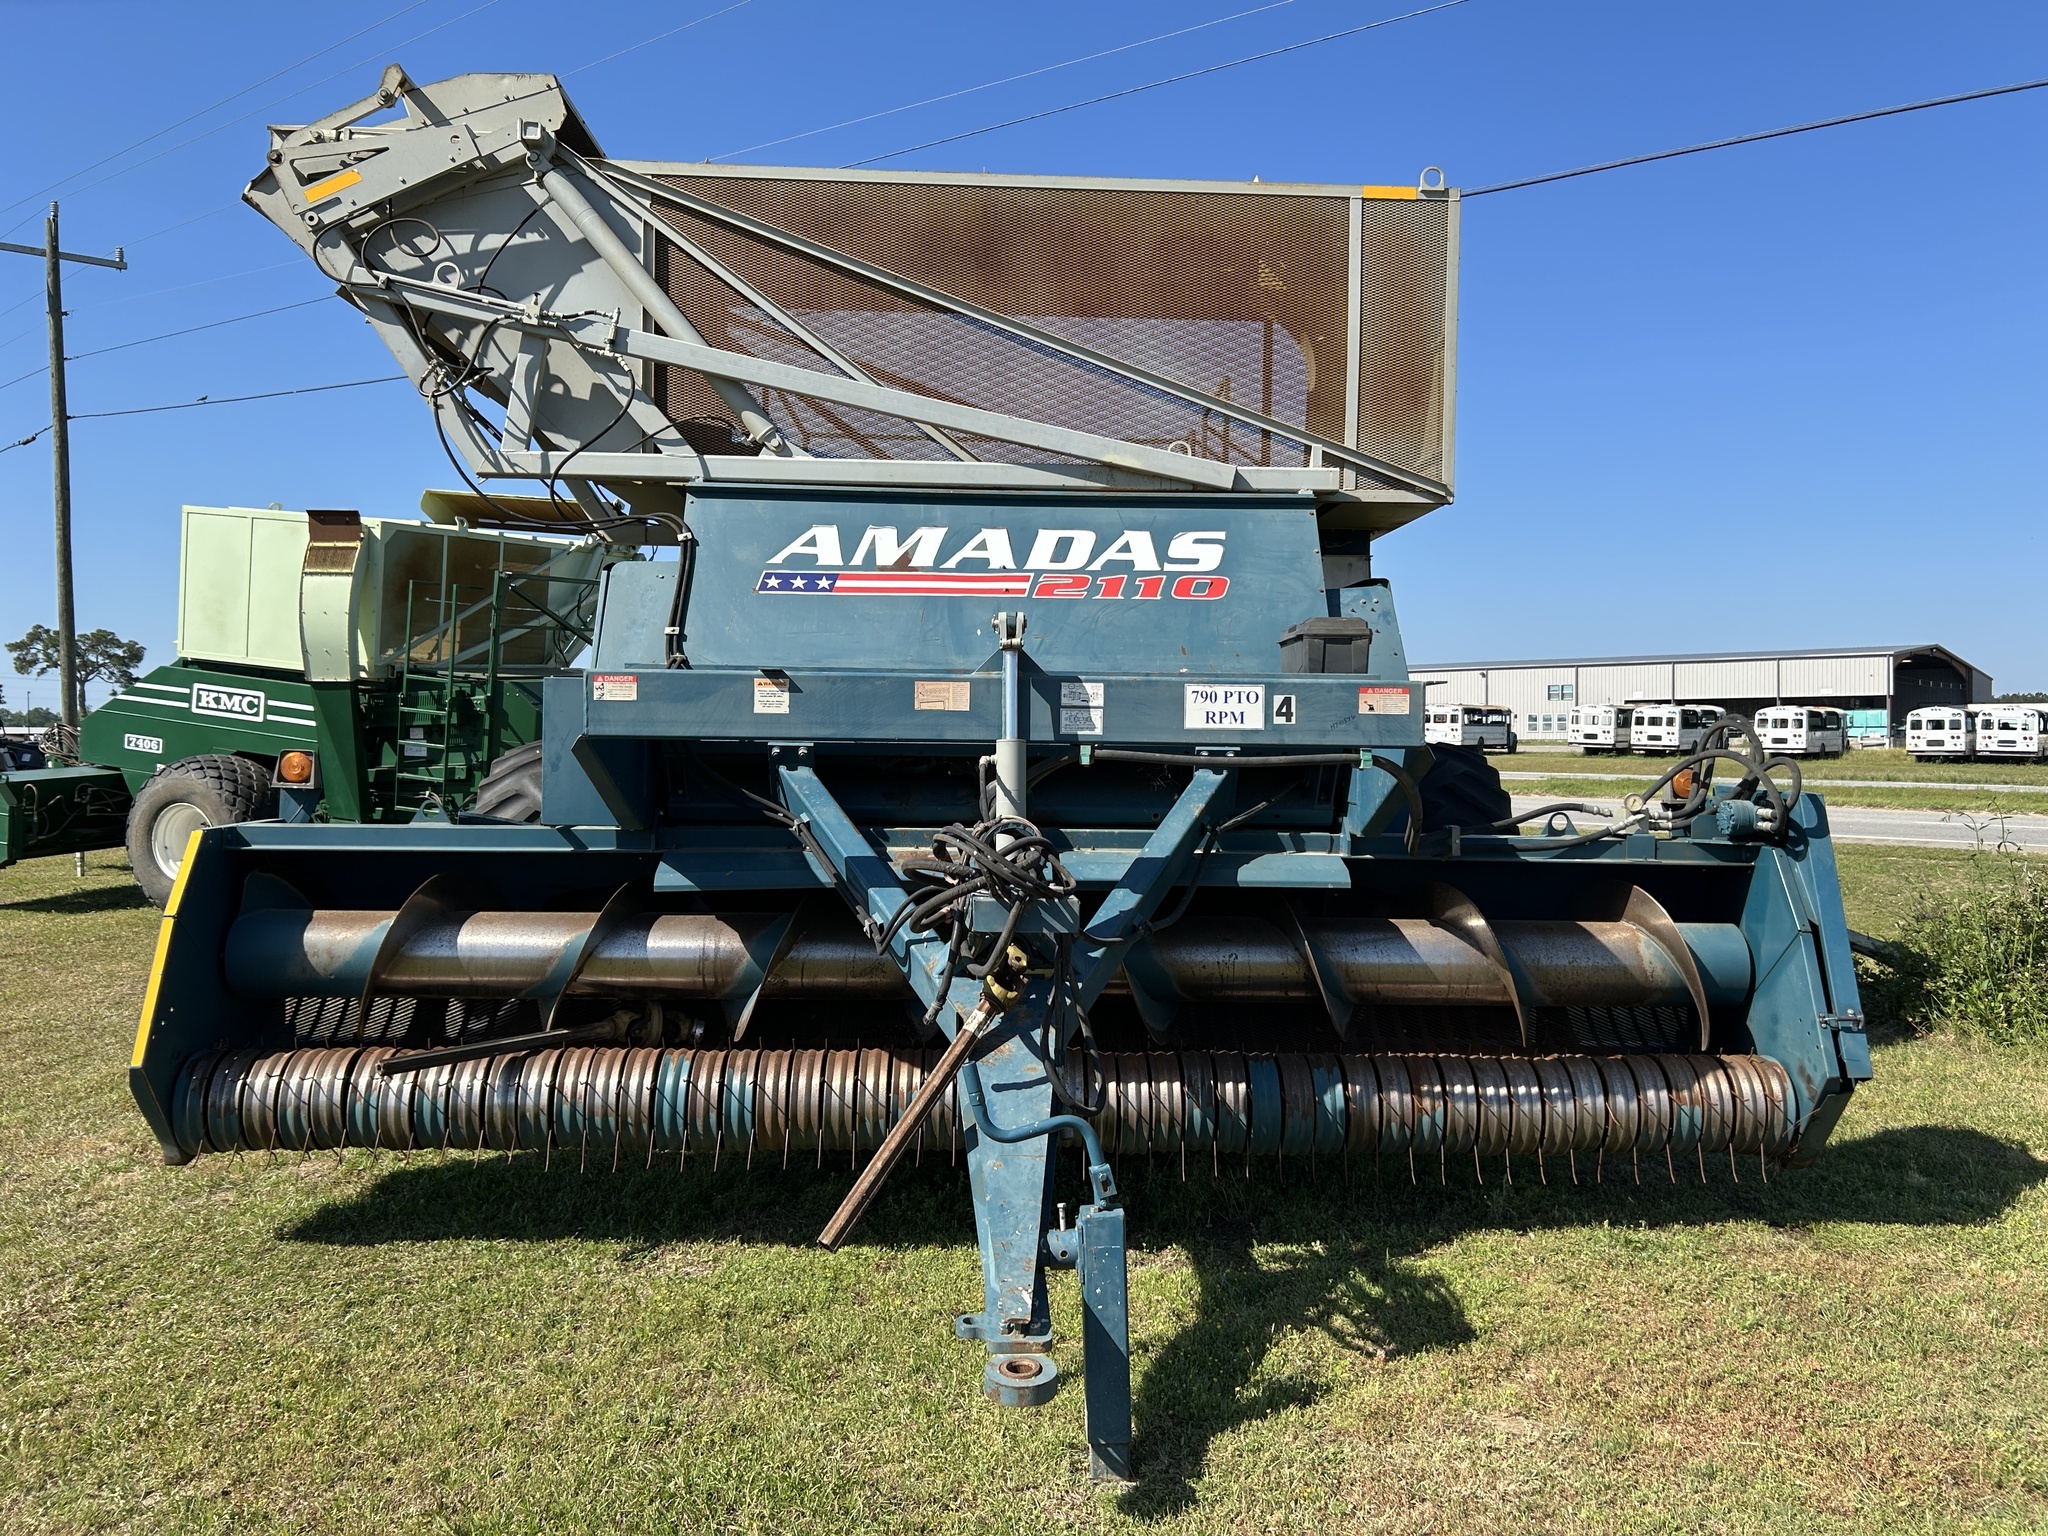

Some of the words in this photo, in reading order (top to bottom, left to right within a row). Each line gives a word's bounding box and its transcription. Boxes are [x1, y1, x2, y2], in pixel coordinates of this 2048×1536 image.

[765, 524, 1228, 572] AMADAS
[1032, 572, 1231, 600] 2110
[198, 690, 259, 714] KMC
[1191, 690, 1218, 704] 790
[1223, 690, 1259, 704] PTO
[1205, 711, 1246, 725] RPM
[1275, 696, 1294, 723] 4
[128, 737, 159, 751] 7406
